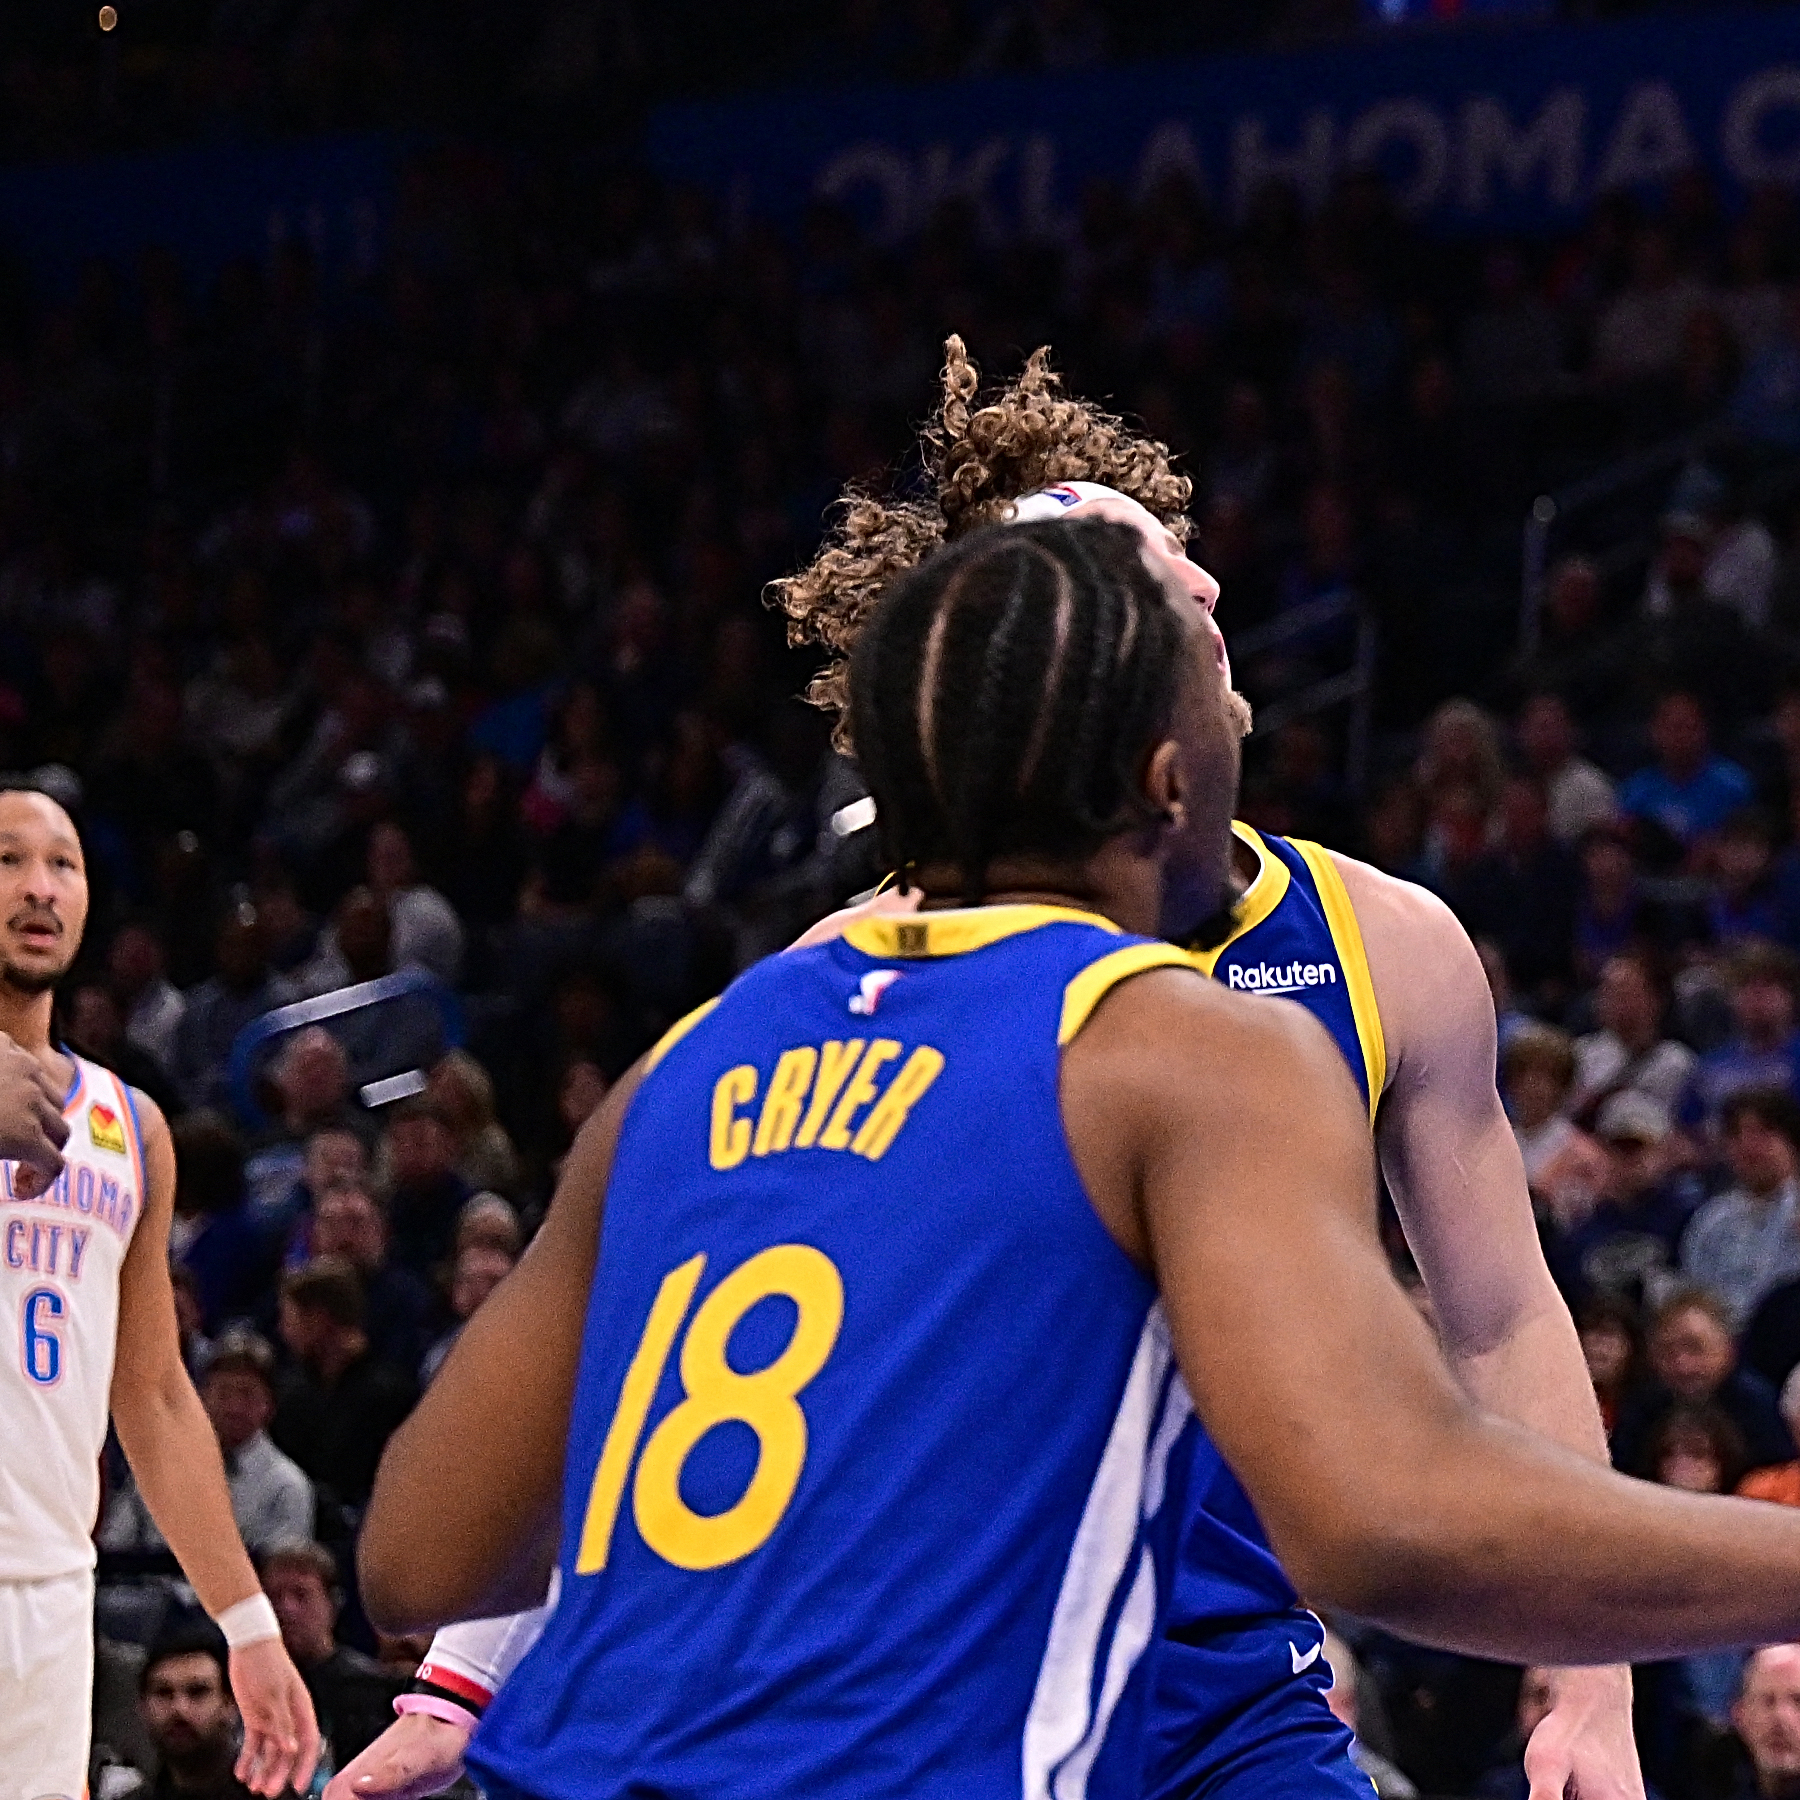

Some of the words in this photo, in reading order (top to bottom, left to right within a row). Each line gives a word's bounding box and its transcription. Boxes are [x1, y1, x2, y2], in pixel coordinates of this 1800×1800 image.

[1228, 960, 1337, 991] Rakuten
[710, 1038, 946, 1171] CRYER
[6, 1217, 91, 1279] CITY
[20, 1284, 65, 1388] 6
[576, 1243, 845, 1575] 18
